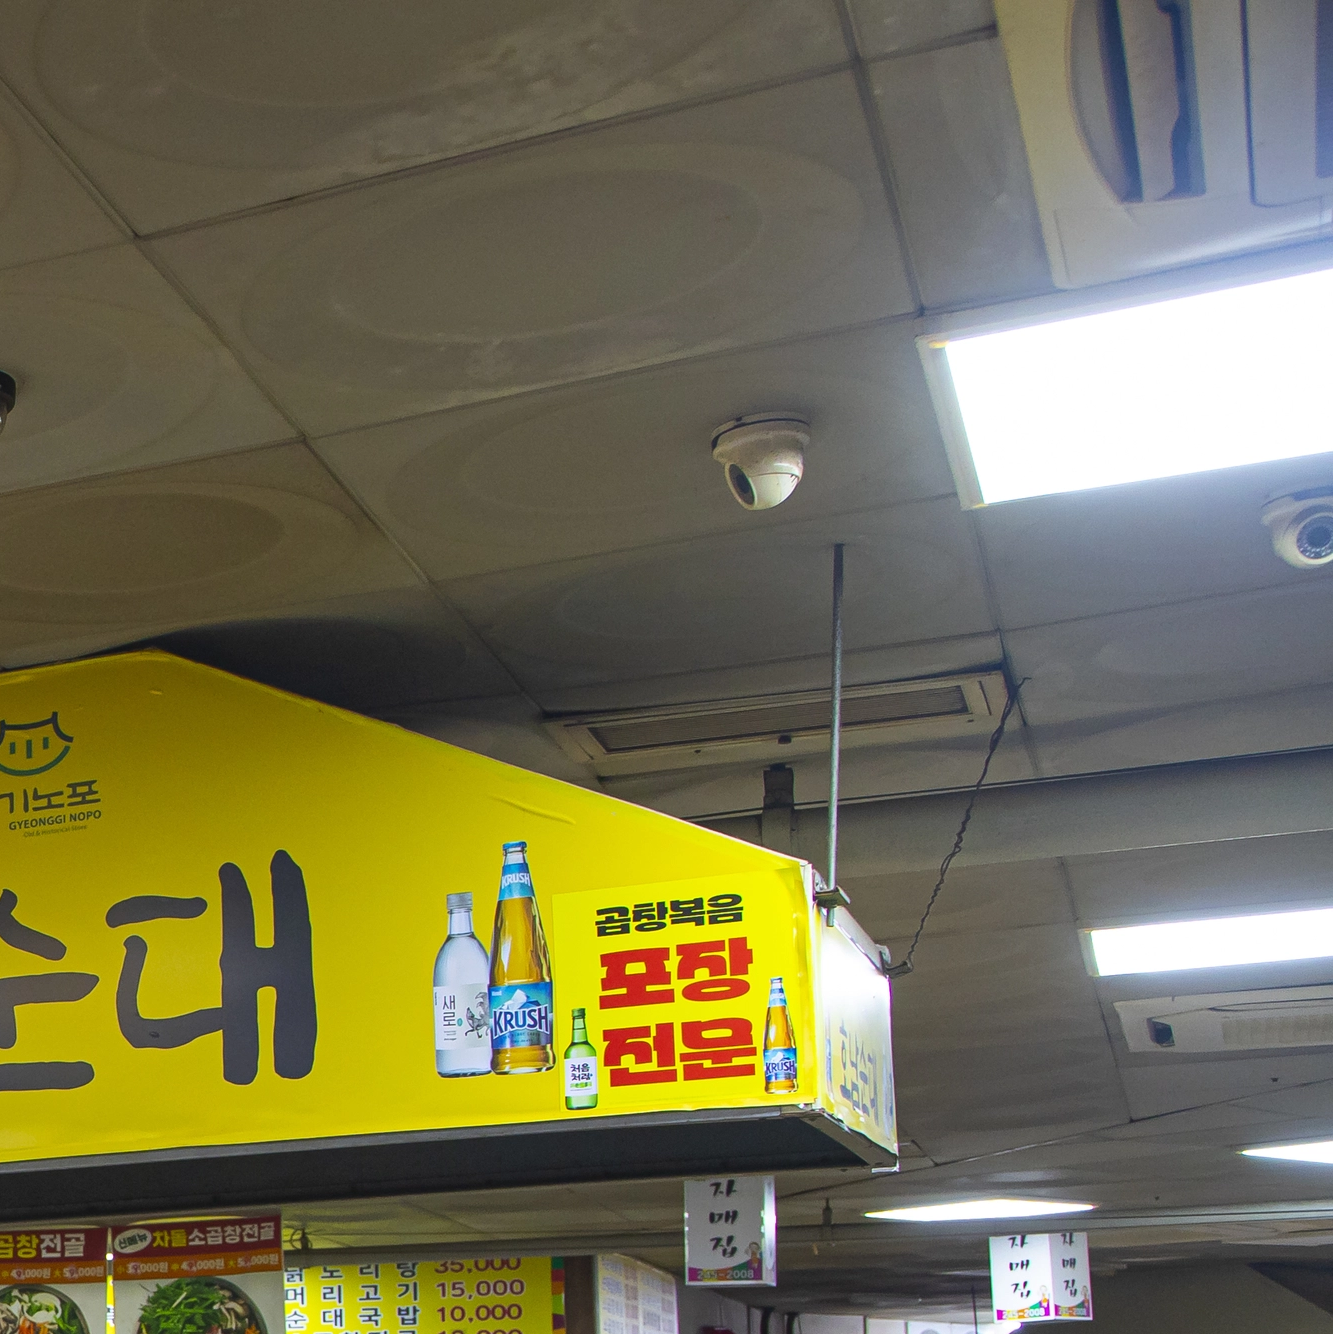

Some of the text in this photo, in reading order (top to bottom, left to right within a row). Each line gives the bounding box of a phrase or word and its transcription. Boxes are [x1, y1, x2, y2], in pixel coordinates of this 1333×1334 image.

[8, 809, 102, 832] GYEONGGI NOPO
[501, 872, 531, 888] KRUSH
[599, 936, 754, 1010] 포장
[492, 1004, 550, 1034] KRUSH
[602, 1017, 758, 1088] 전문
[765, 1059, 796, 1076] KRUSH
[709, 1179, 739, 1258] 자매집
[152, 1221, 275, 1249] 차돌소곱창전골
[434, 1258, 522, 1274] 35,000
[1008, 1234, 1031, 1299] 자매집
[1060, 1232, 1078, 1298] 자매집
[286, 1279, 526, 1306] 머리고기 15,000
[286, 1303, 523, 1330] 순대국밥 10,000
